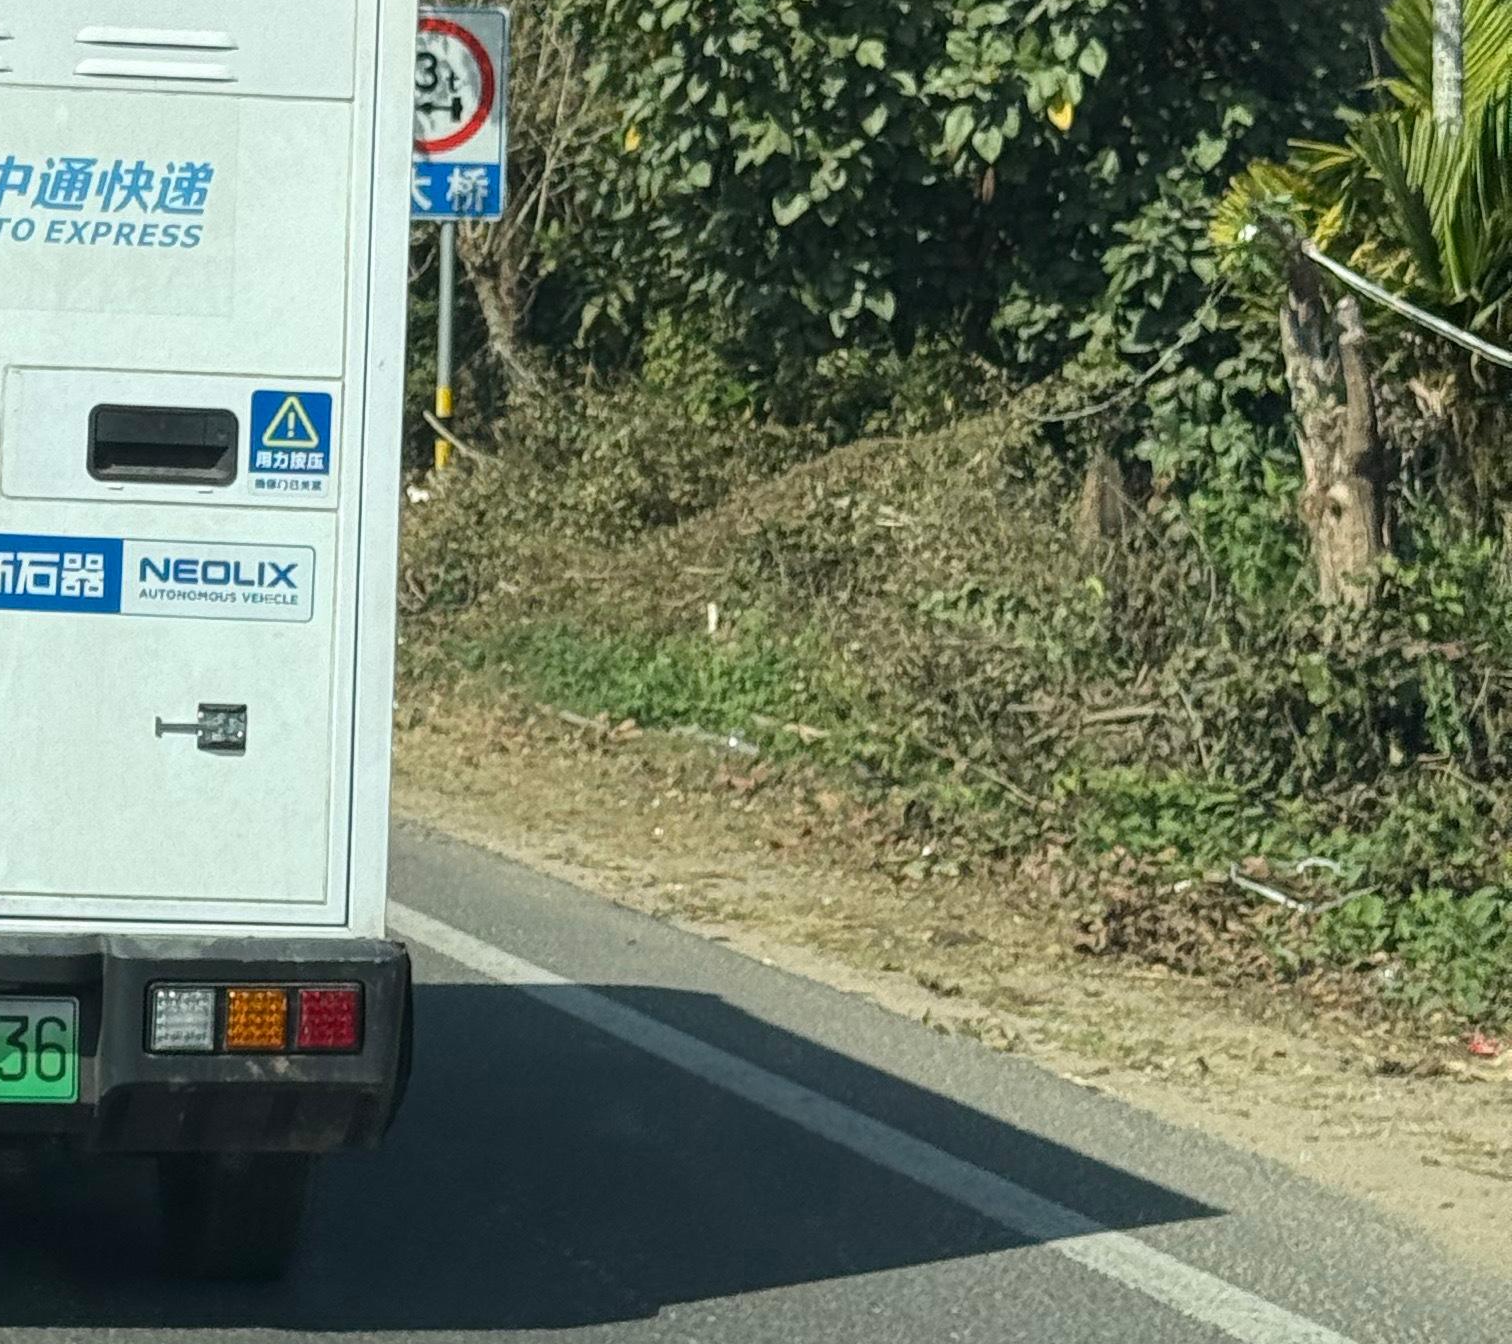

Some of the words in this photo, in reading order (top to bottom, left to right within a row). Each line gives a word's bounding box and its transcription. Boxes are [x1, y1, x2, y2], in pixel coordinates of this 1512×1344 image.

[44, 219, 204, 249] EXPRESS
[255, 450, 325, 470] 用力按压
[139, 557, 299, 588] NEOLIX
[139, 587, 237, 604] AUTONOMOUS
[242, 592, 299, 606] VEHICLE
